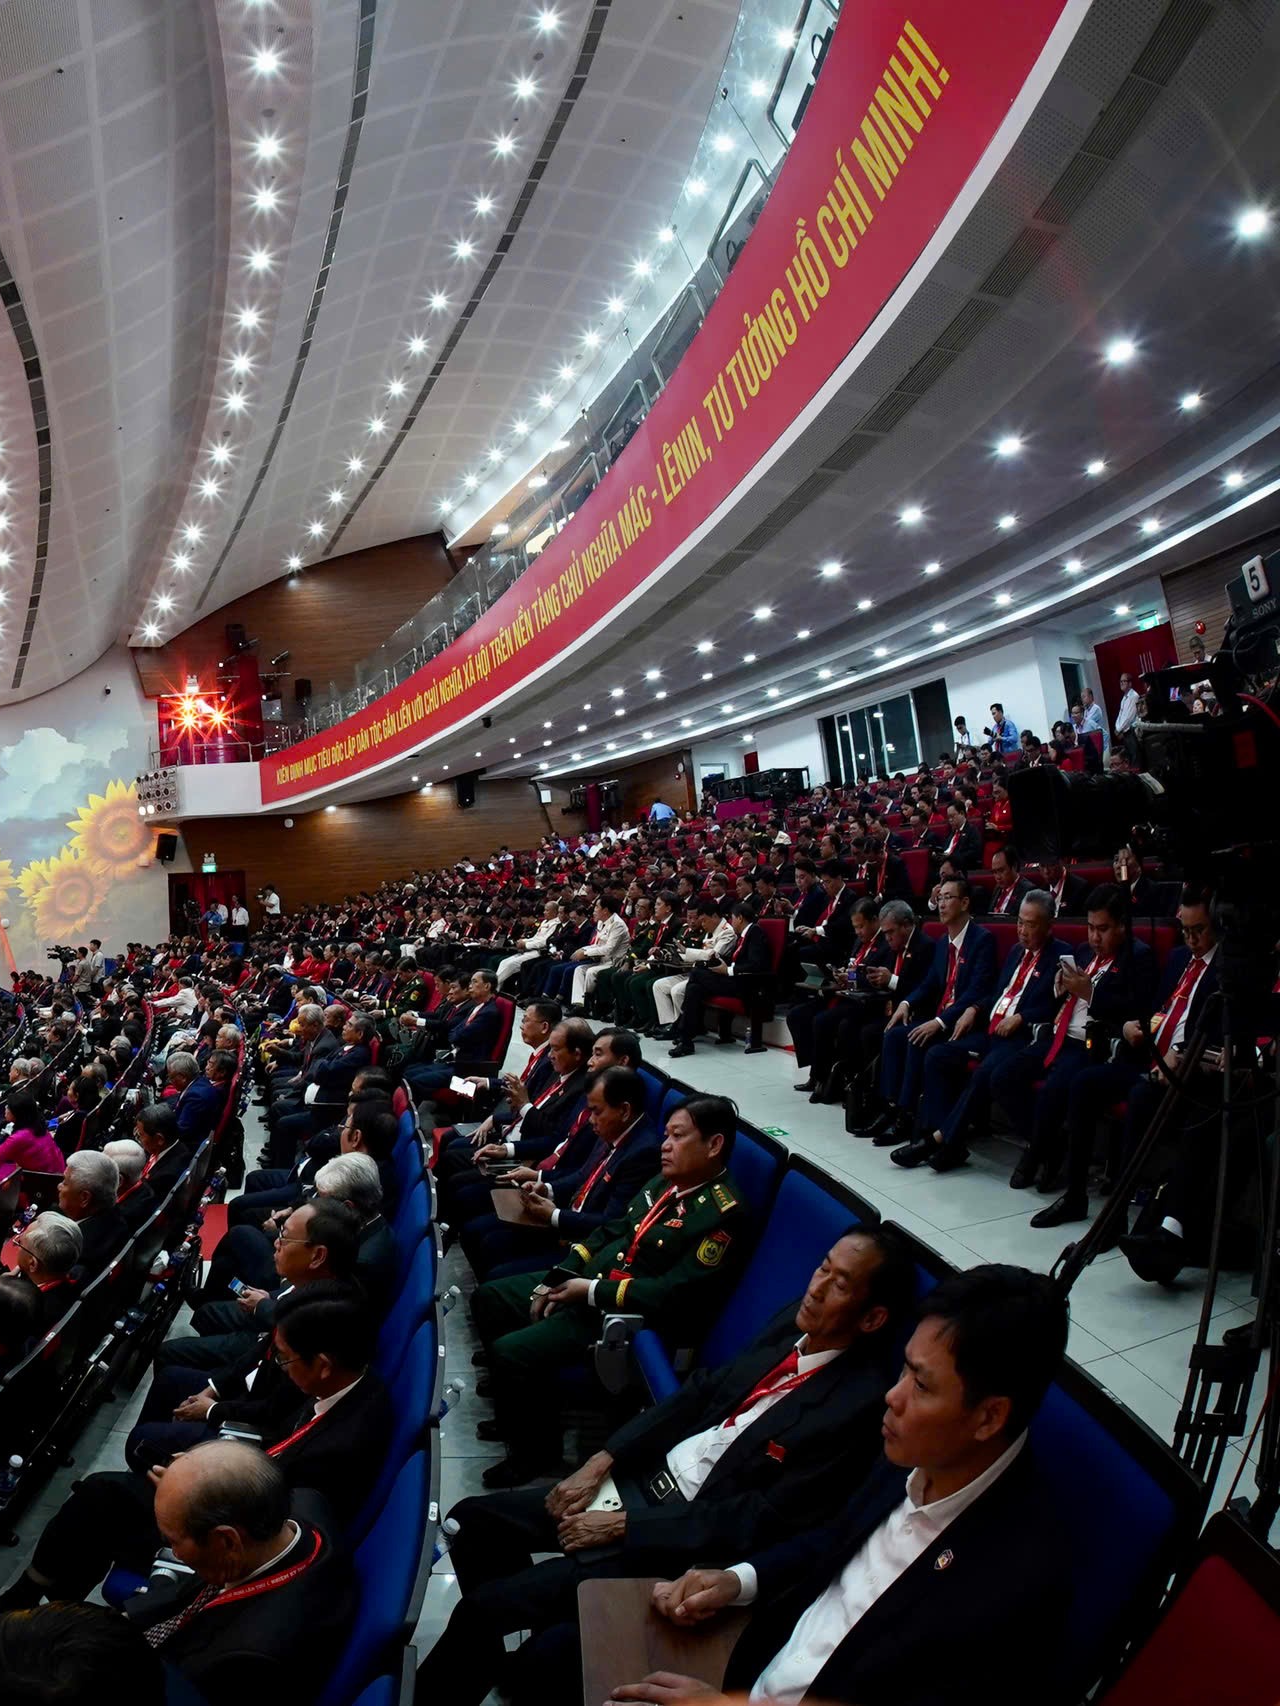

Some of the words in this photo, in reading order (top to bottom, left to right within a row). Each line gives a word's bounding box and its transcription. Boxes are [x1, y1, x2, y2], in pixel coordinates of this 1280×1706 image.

[277, 766, 290, 784] KIÊN
[289, 761, 304, 780] ĐỊNH
[304, 755, 317, 775] MỤC
[317, 748, 331, 768] TIÊU
[331, 743, 344, 764] ĐỘC
[344, 736, 357, 760] LẬP
[356, 728, 370, 753] DÂN
[369, 721, 383, 745] TỘC
[382, 713, 397, 740] GẮN
[396, 702, 412, 732] LIỀN
[410, 694, 424, 721] VỚI
[423, 679, 440, 713] CHỦ
[439, 667, 464, 704] NGHĨA
[463, 654, 477, 688] XÃ
[476, 648, 490, 682] HỘI
[489, 630, 514, 666] TRÊN
[512, 608, 534, 650] NỀN
[533, 587, 561, 632] TẢNG
[559, 551, 582, 608] CHỦ
[581, 521, 621, 582] NGHĨA
[618, 486, 652, 545] MÁC
[703, 374, 734, 439] TƯ
[726, 288, 798, 408] TƯỞNG
[785, 219, 830, 321] HỒ
[816, 148, 874, 268] CHÍ
[851, 20, 950, 201] MINH!
[1249, 566, 1260, 592] 5
[1252, 598, 1277, 619] SONY
